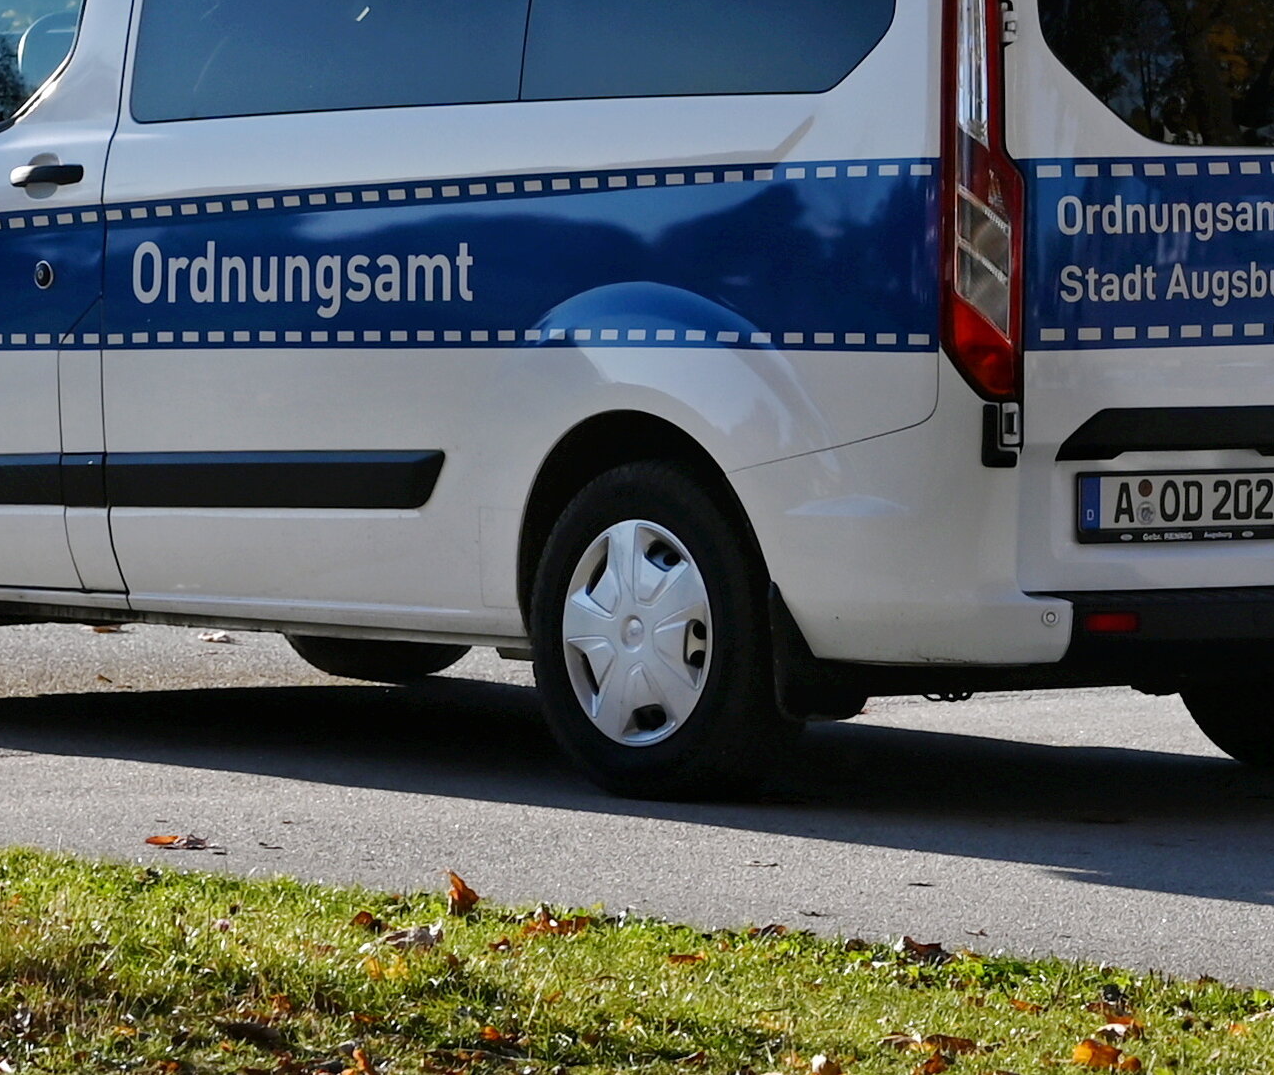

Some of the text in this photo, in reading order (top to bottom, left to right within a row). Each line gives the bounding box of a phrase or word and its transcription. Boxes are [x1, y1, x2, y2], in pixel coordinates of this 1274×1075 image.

[132, 240, 474, 319] Ordnungsamt
[1060, 264, 1157, 303] Stadt
[1086, 509, 1095, 521] D
[1114, 478, 1274, 524] A OD 202
[1203, 531, 1233, 540] Augsburg
